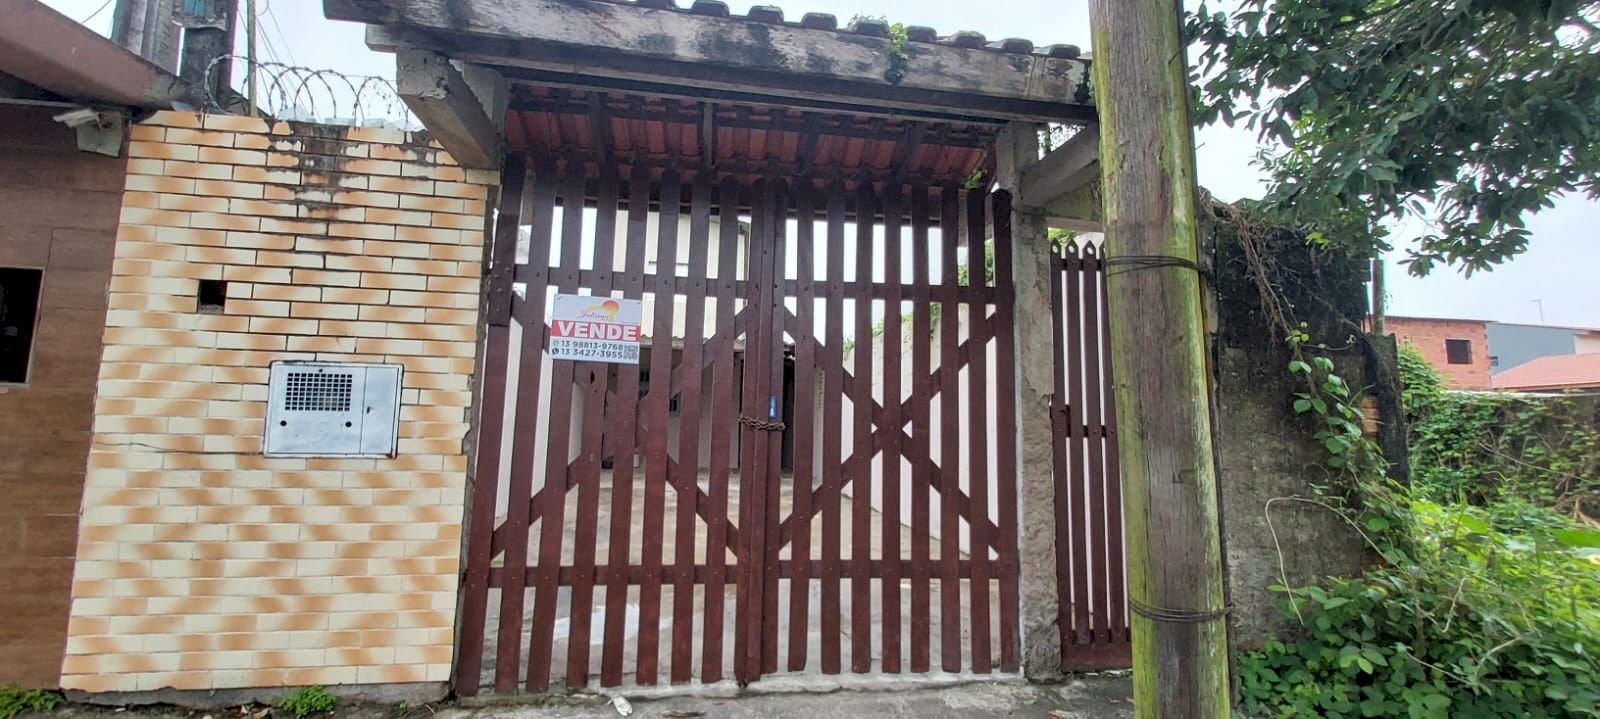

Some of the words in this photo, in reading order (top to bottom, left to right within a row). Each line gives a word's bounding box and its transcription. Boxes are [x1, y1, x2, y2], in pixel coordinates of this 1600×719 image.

[557, 320, 637, 341] VENDE
[561, 340, 570, 348] 13
[572, 341, 624, 351] 98813-9768
[561, 348, 570, 356] 13
[572, 349, 623, 359] 3427-3955
